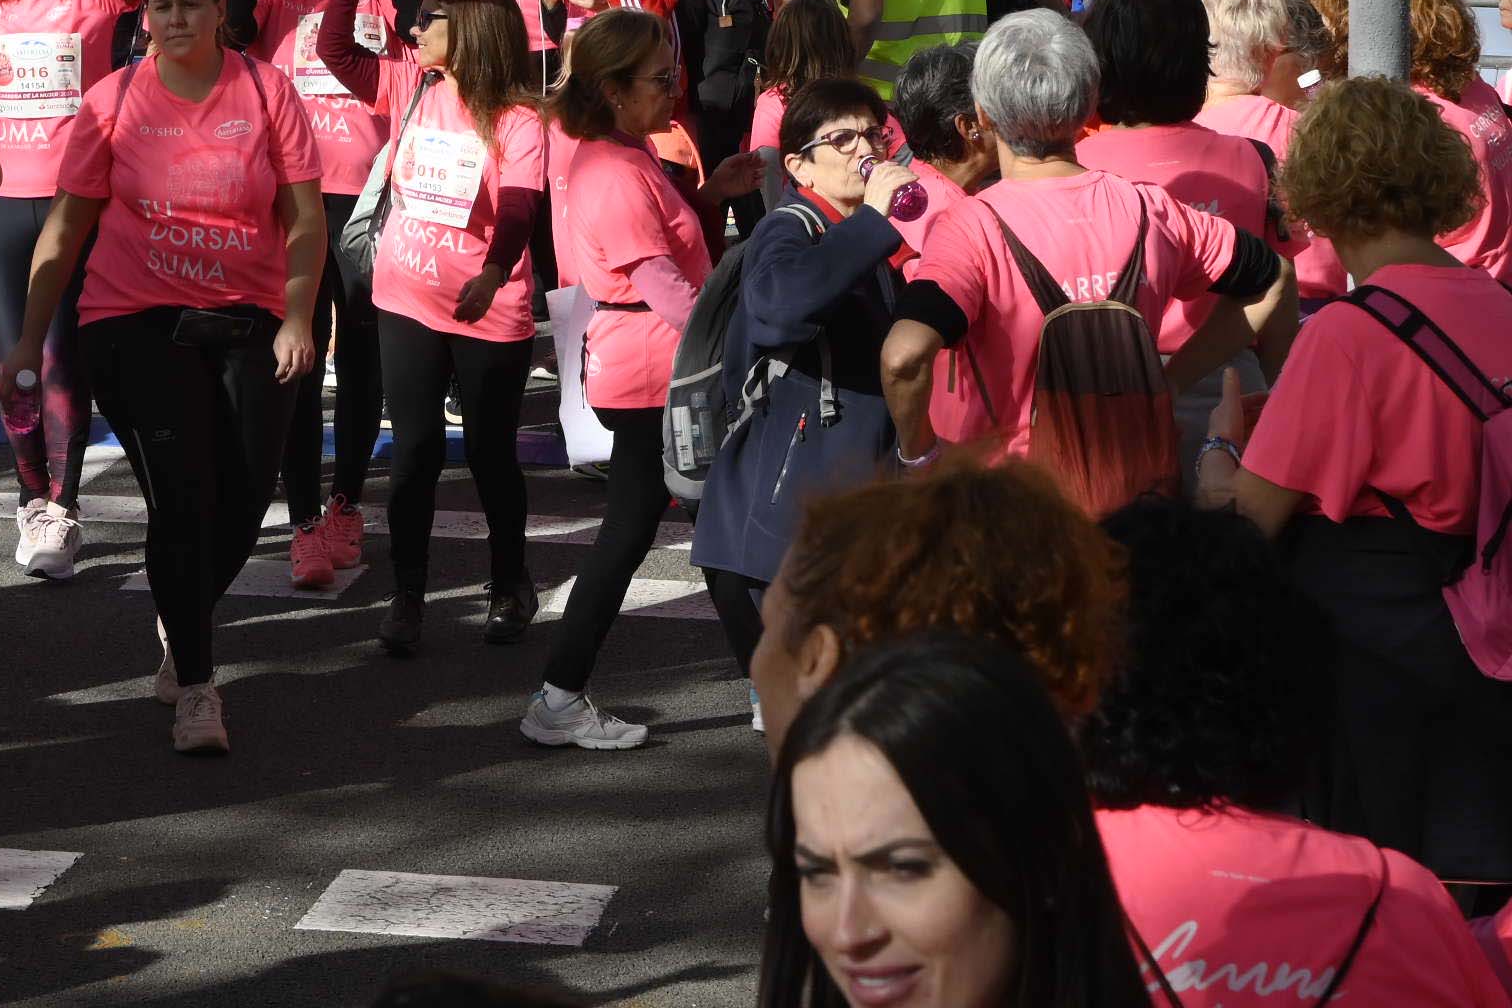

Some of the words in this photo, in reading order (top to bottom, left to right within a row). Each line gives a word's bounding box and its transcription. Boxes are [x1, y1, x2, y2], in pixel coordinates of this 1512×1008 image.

[17, 67, 49, 79] 016
[20, 82, 45, 90] 14154
[139, 125, 184, 137] OYSHO
[312, 111, 350, 135] MA
[417, 165, 447, 181] 016
[418, 182, 442, 192] 14153
[138, 199, 172, 219] TU
[150, 222, 253, 251] DORSAL
[147, 250, 225, 281] SUMA
